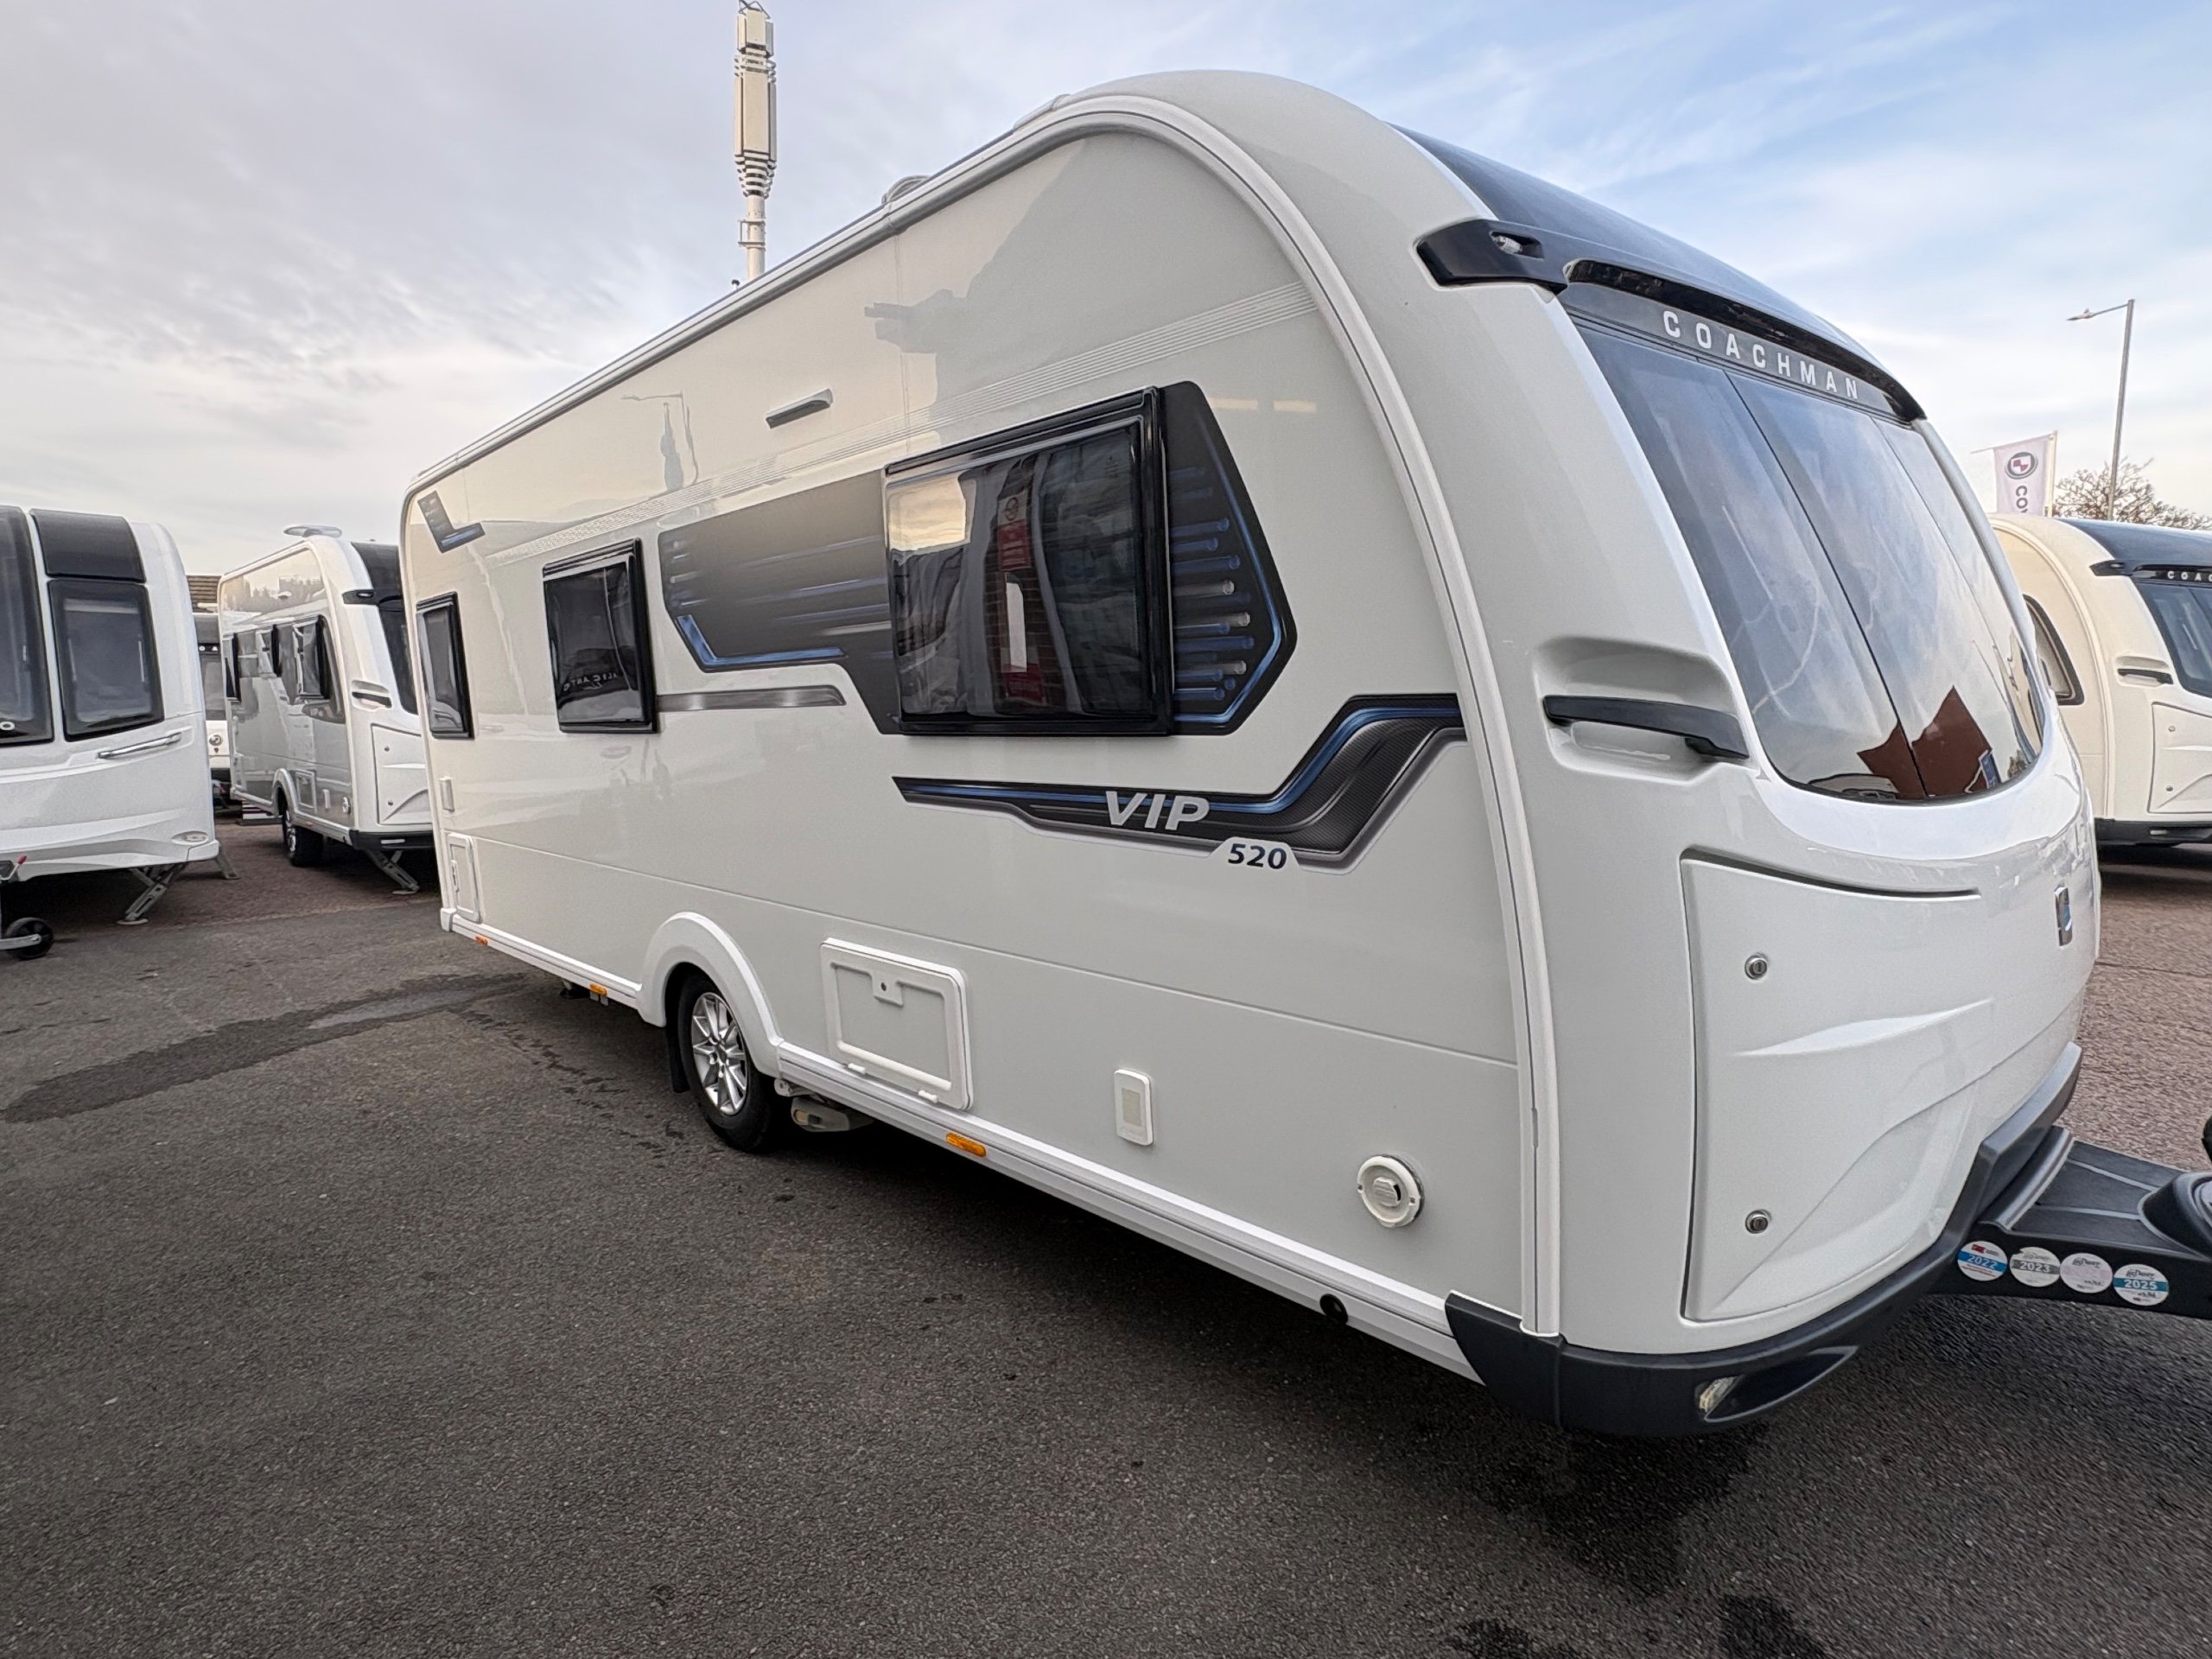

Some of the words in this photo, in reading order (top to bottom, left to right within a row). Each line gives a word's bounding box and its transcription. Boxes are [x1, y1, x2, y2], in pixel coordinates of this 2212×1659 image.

[1663, 310, 1858, 399] COACHMAN
[2015, 485, 2028, 513] CO
[1105, 790, 1210, 830] VIP
[1228, 842, 1287, 869] 520
[1966, 1254, 1998, 1269] 2022
[2019, 1261, 2050, 1273] 2023
[2124, 1279, 2158, 1290] 2025
